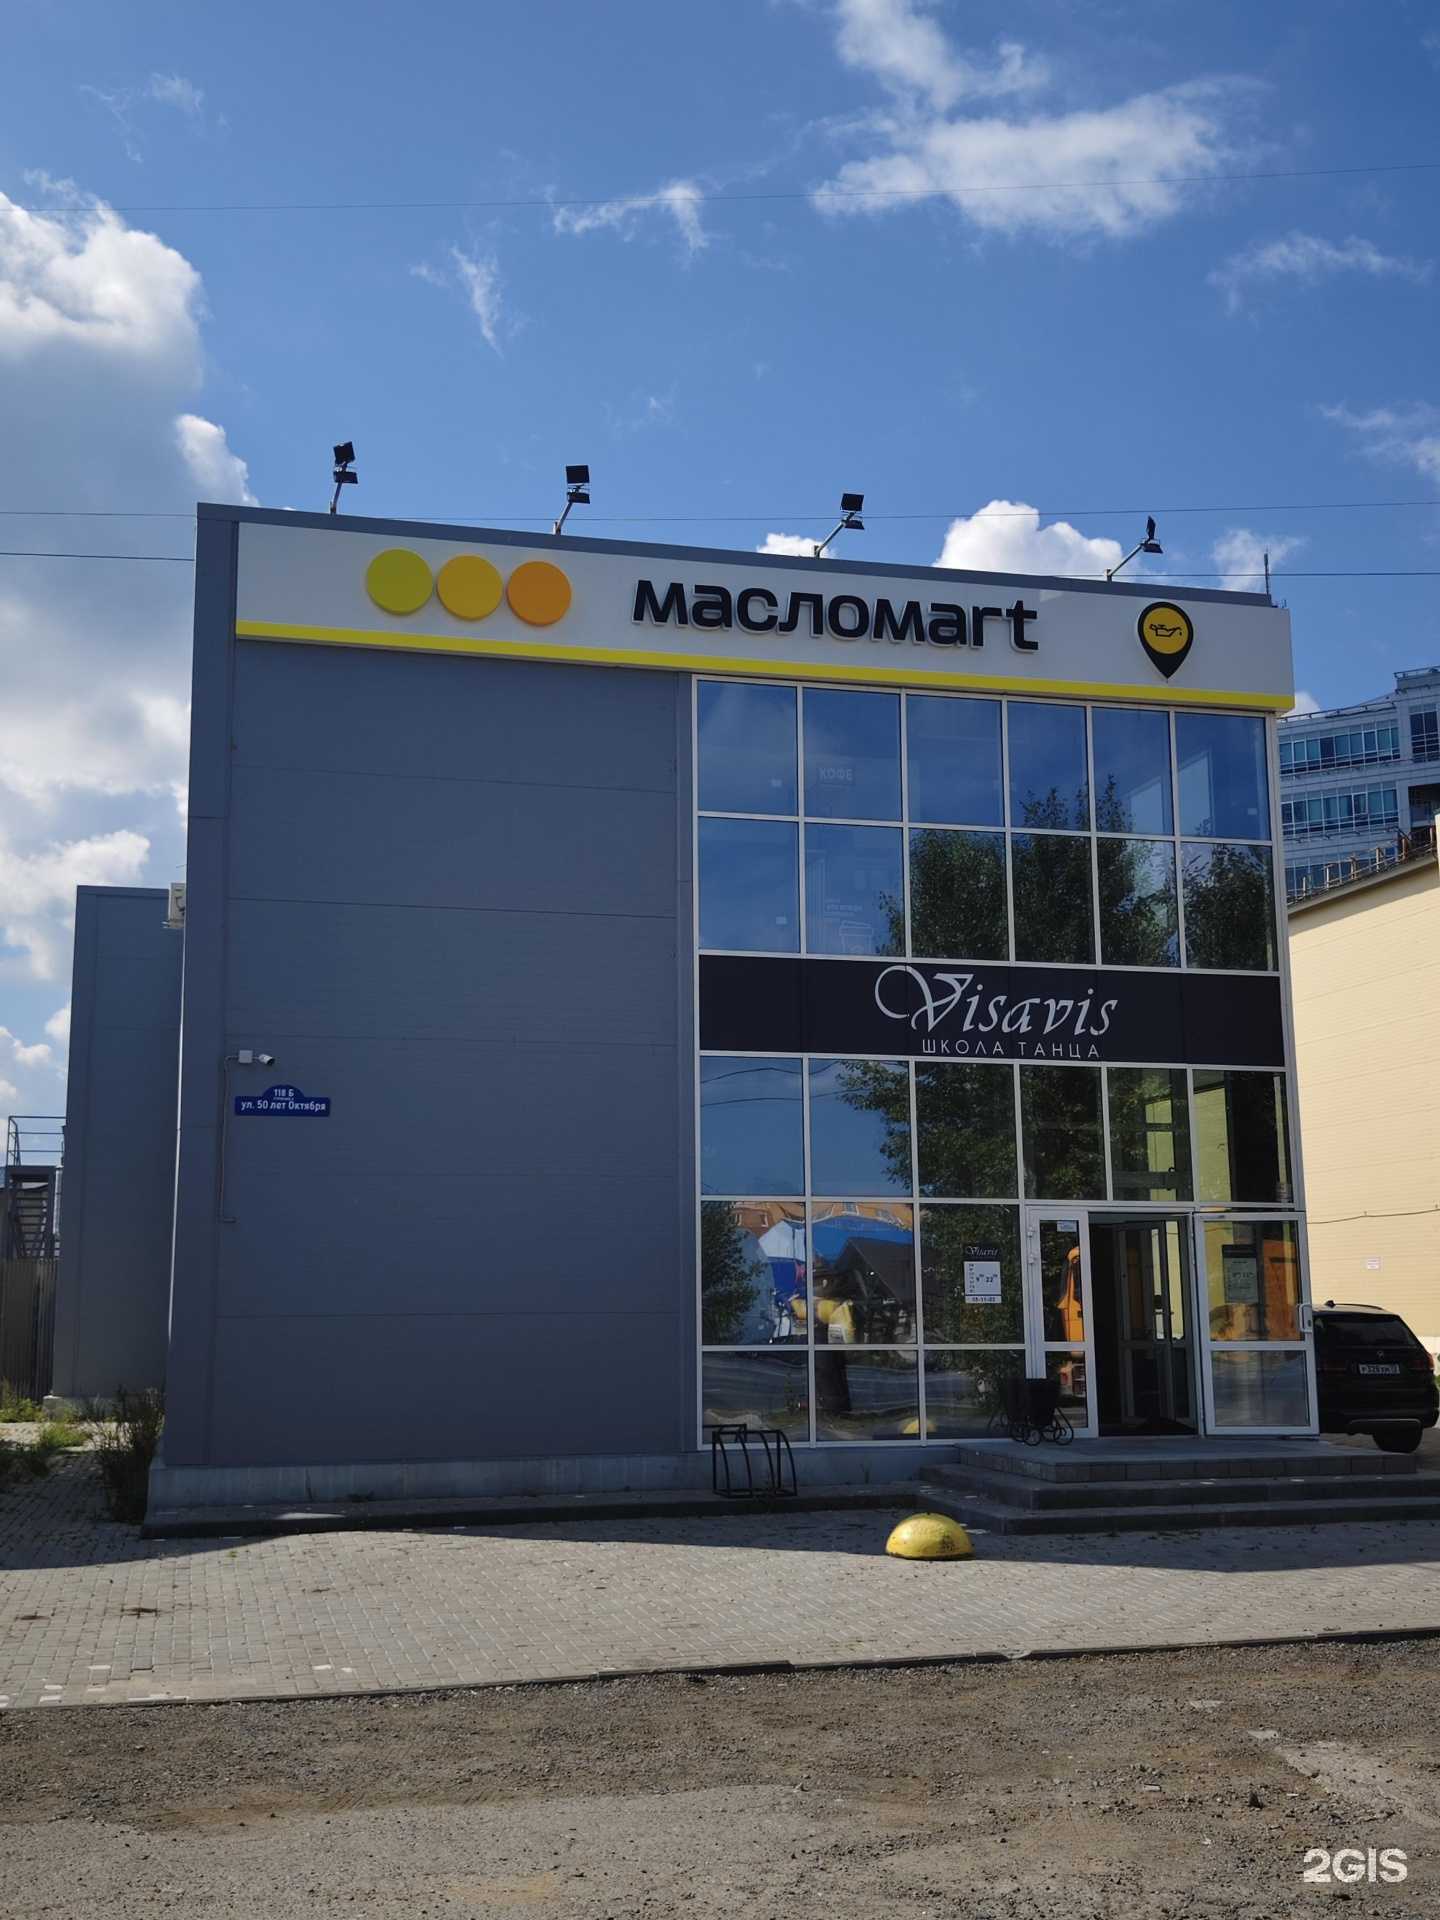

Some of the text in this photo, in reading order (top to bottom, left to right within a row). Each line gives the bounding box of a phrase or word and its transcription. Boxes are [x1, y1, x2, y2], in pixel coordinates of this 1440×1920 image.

[875, 965, 1118, 1036] Visavis
[922, 1039, 1100, 1058] ШКОЛА ТАНЦА
[241, 1100, 326, 1112] ул. 50 лет Октября
